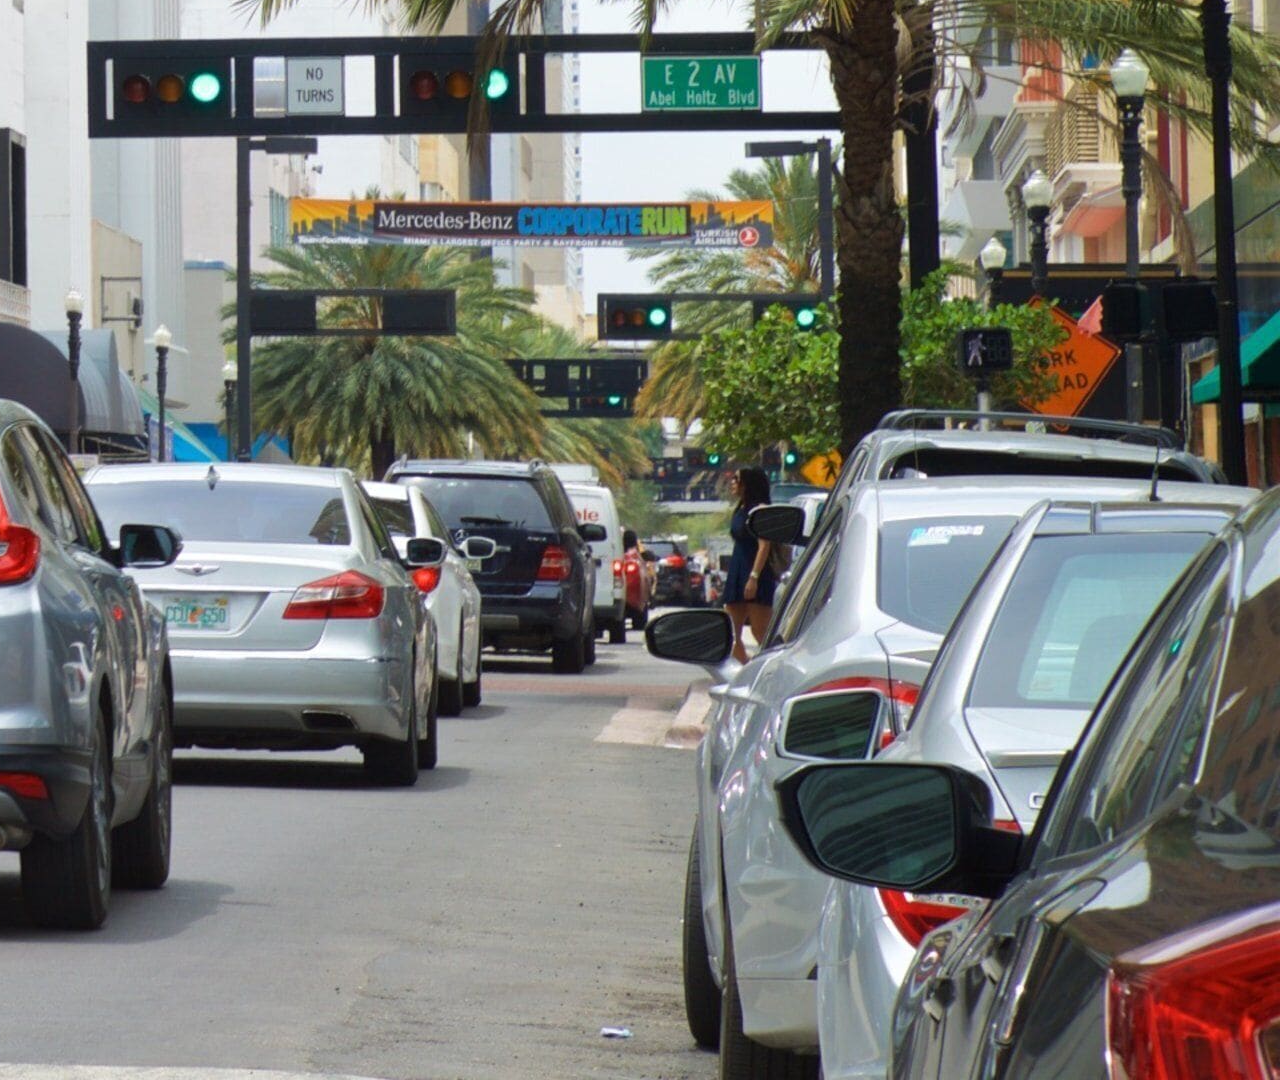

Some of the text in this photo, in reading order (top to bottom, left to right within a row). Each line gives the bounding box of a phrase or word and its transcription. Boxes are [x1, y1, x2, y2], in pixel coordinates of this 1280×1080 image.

[306, 67, 324, 81] NO
[665, 61, 736, 87] E 2 AV
[296, 89, 334, 103] TURNS
[649, 88, 755, 105] Abel Holtz Blvd
[378, 210, 513, 230] Mercedes-Benz
[694, 229, 739, 238] TURKISH
[440, 238, 478, 246] LARGEST
[480, 238, 511, 247] OFFICE
[514, 238, 541, 247] PARTY
[553, 239, 599, 247] BAYFRONT
[601, 239, 624, 247] PARK
[694, 237, 739, 246] AIRLINES
